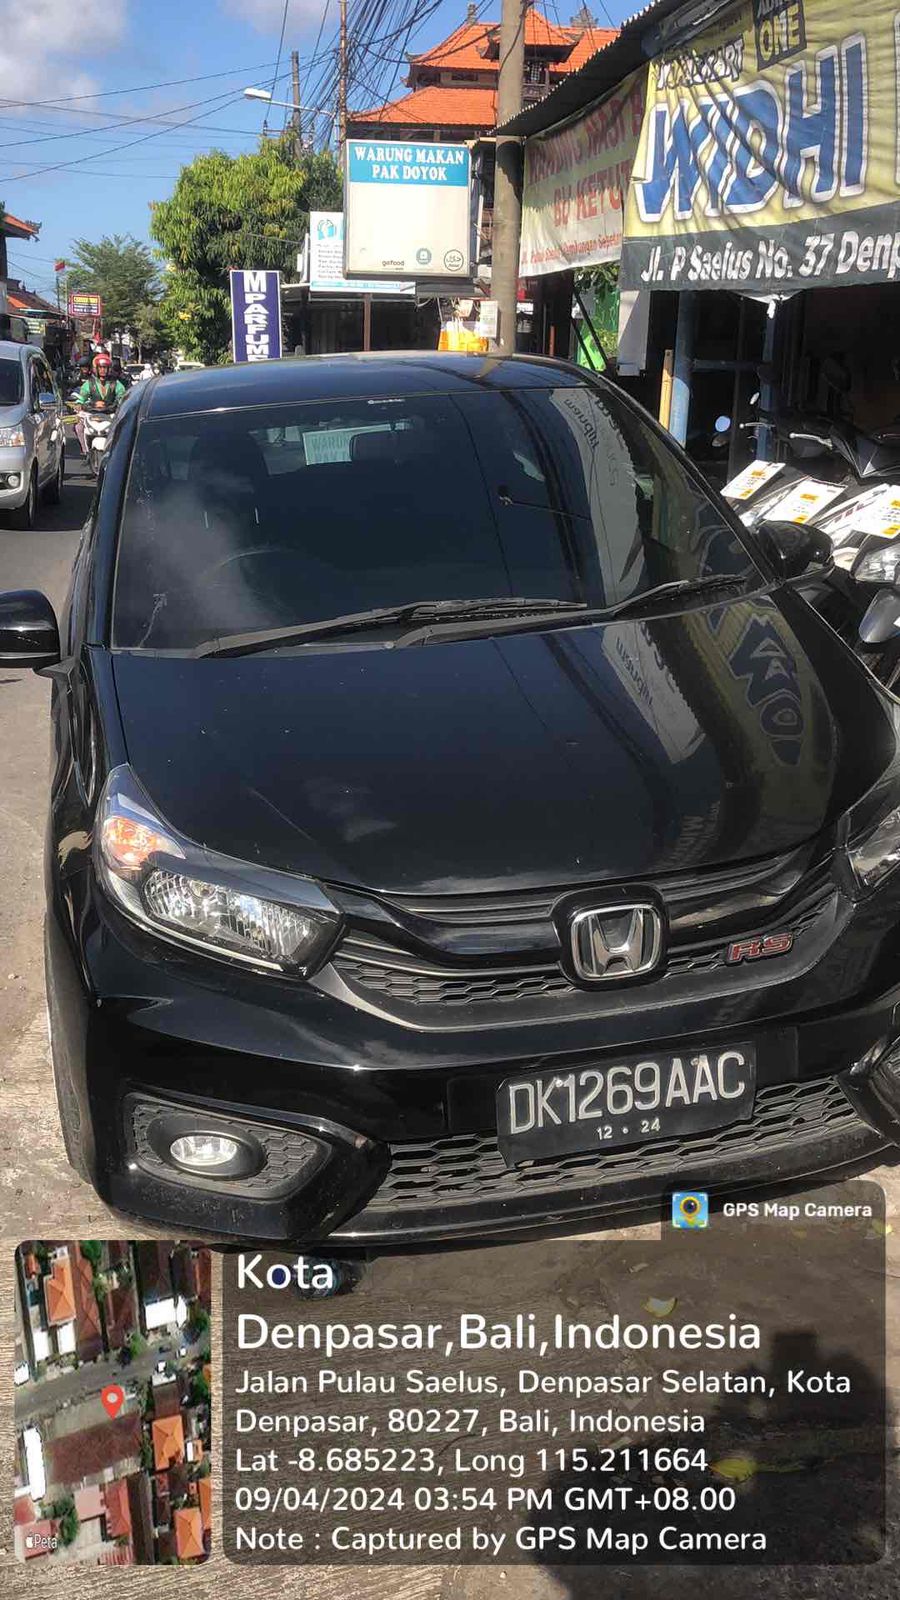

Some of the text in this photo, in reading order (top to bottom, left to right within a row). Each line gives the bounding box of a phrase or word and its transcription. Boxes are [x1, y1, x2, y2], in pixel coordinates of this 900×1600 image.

[760, 3, 800, 61] ONE
[354, 146, 464, 165] WARUNG MAKAN
[372, 164, 447, 181] PAK DOYOK
[670, 246, 687, 281] P
[755, 239, 793, 279] No.
[799, 233, 835, 276] 37
[727, 932, 794, 961] RS
[596, 1117, 661, 1141] 12 24
